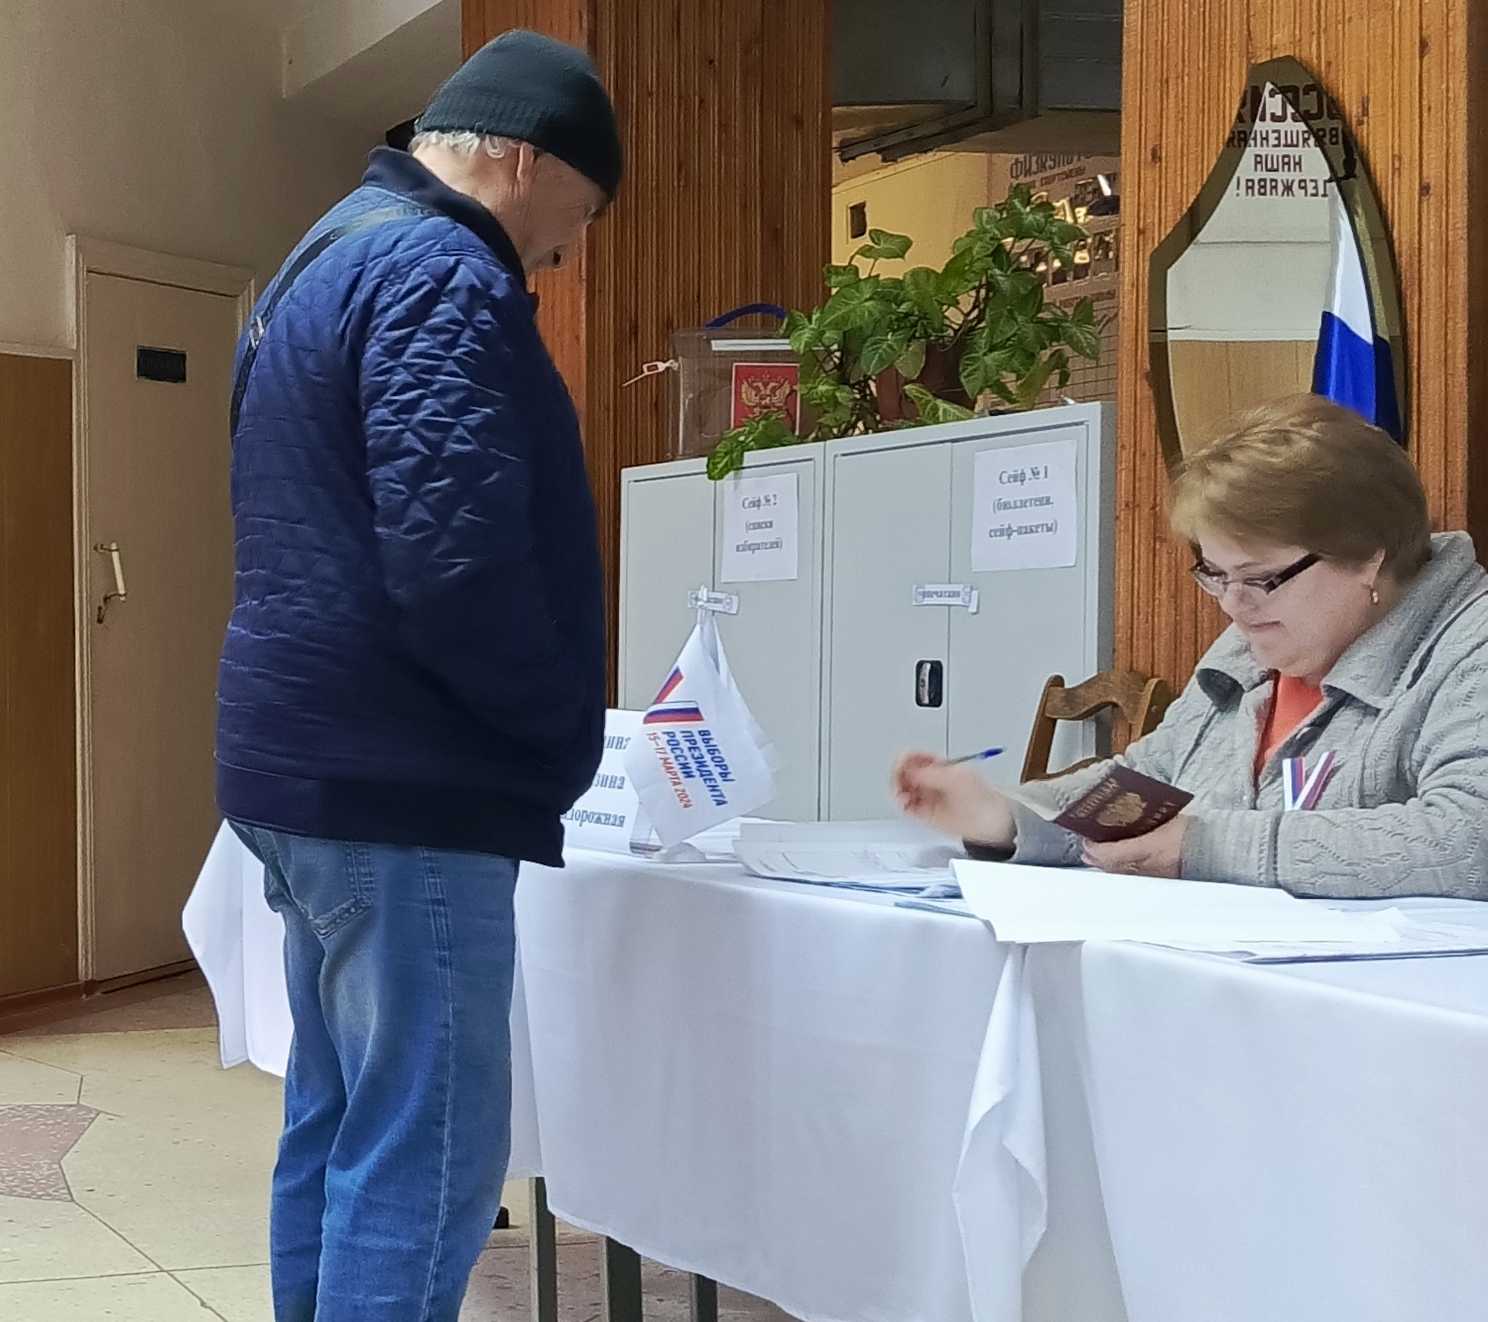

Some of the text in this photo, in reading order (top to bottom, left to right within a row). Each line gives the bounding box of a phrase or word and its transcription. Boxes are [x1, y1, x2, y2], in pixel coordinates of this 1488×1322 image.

[998, 465, 1048, 486] Сейф № 1
[742, 495, 762, 511] Сейф
[762, 493, 772, 507] №
[662, 730, 696, 780] РОССИИ
[679, 730, 729, 807] ПРЕЗИДЕНТА
[698, 729, 736, 783] ВЫБОРЫ
[659, 756, 683, 788] МАРТА
[674, 787, 694, 810] 2024
